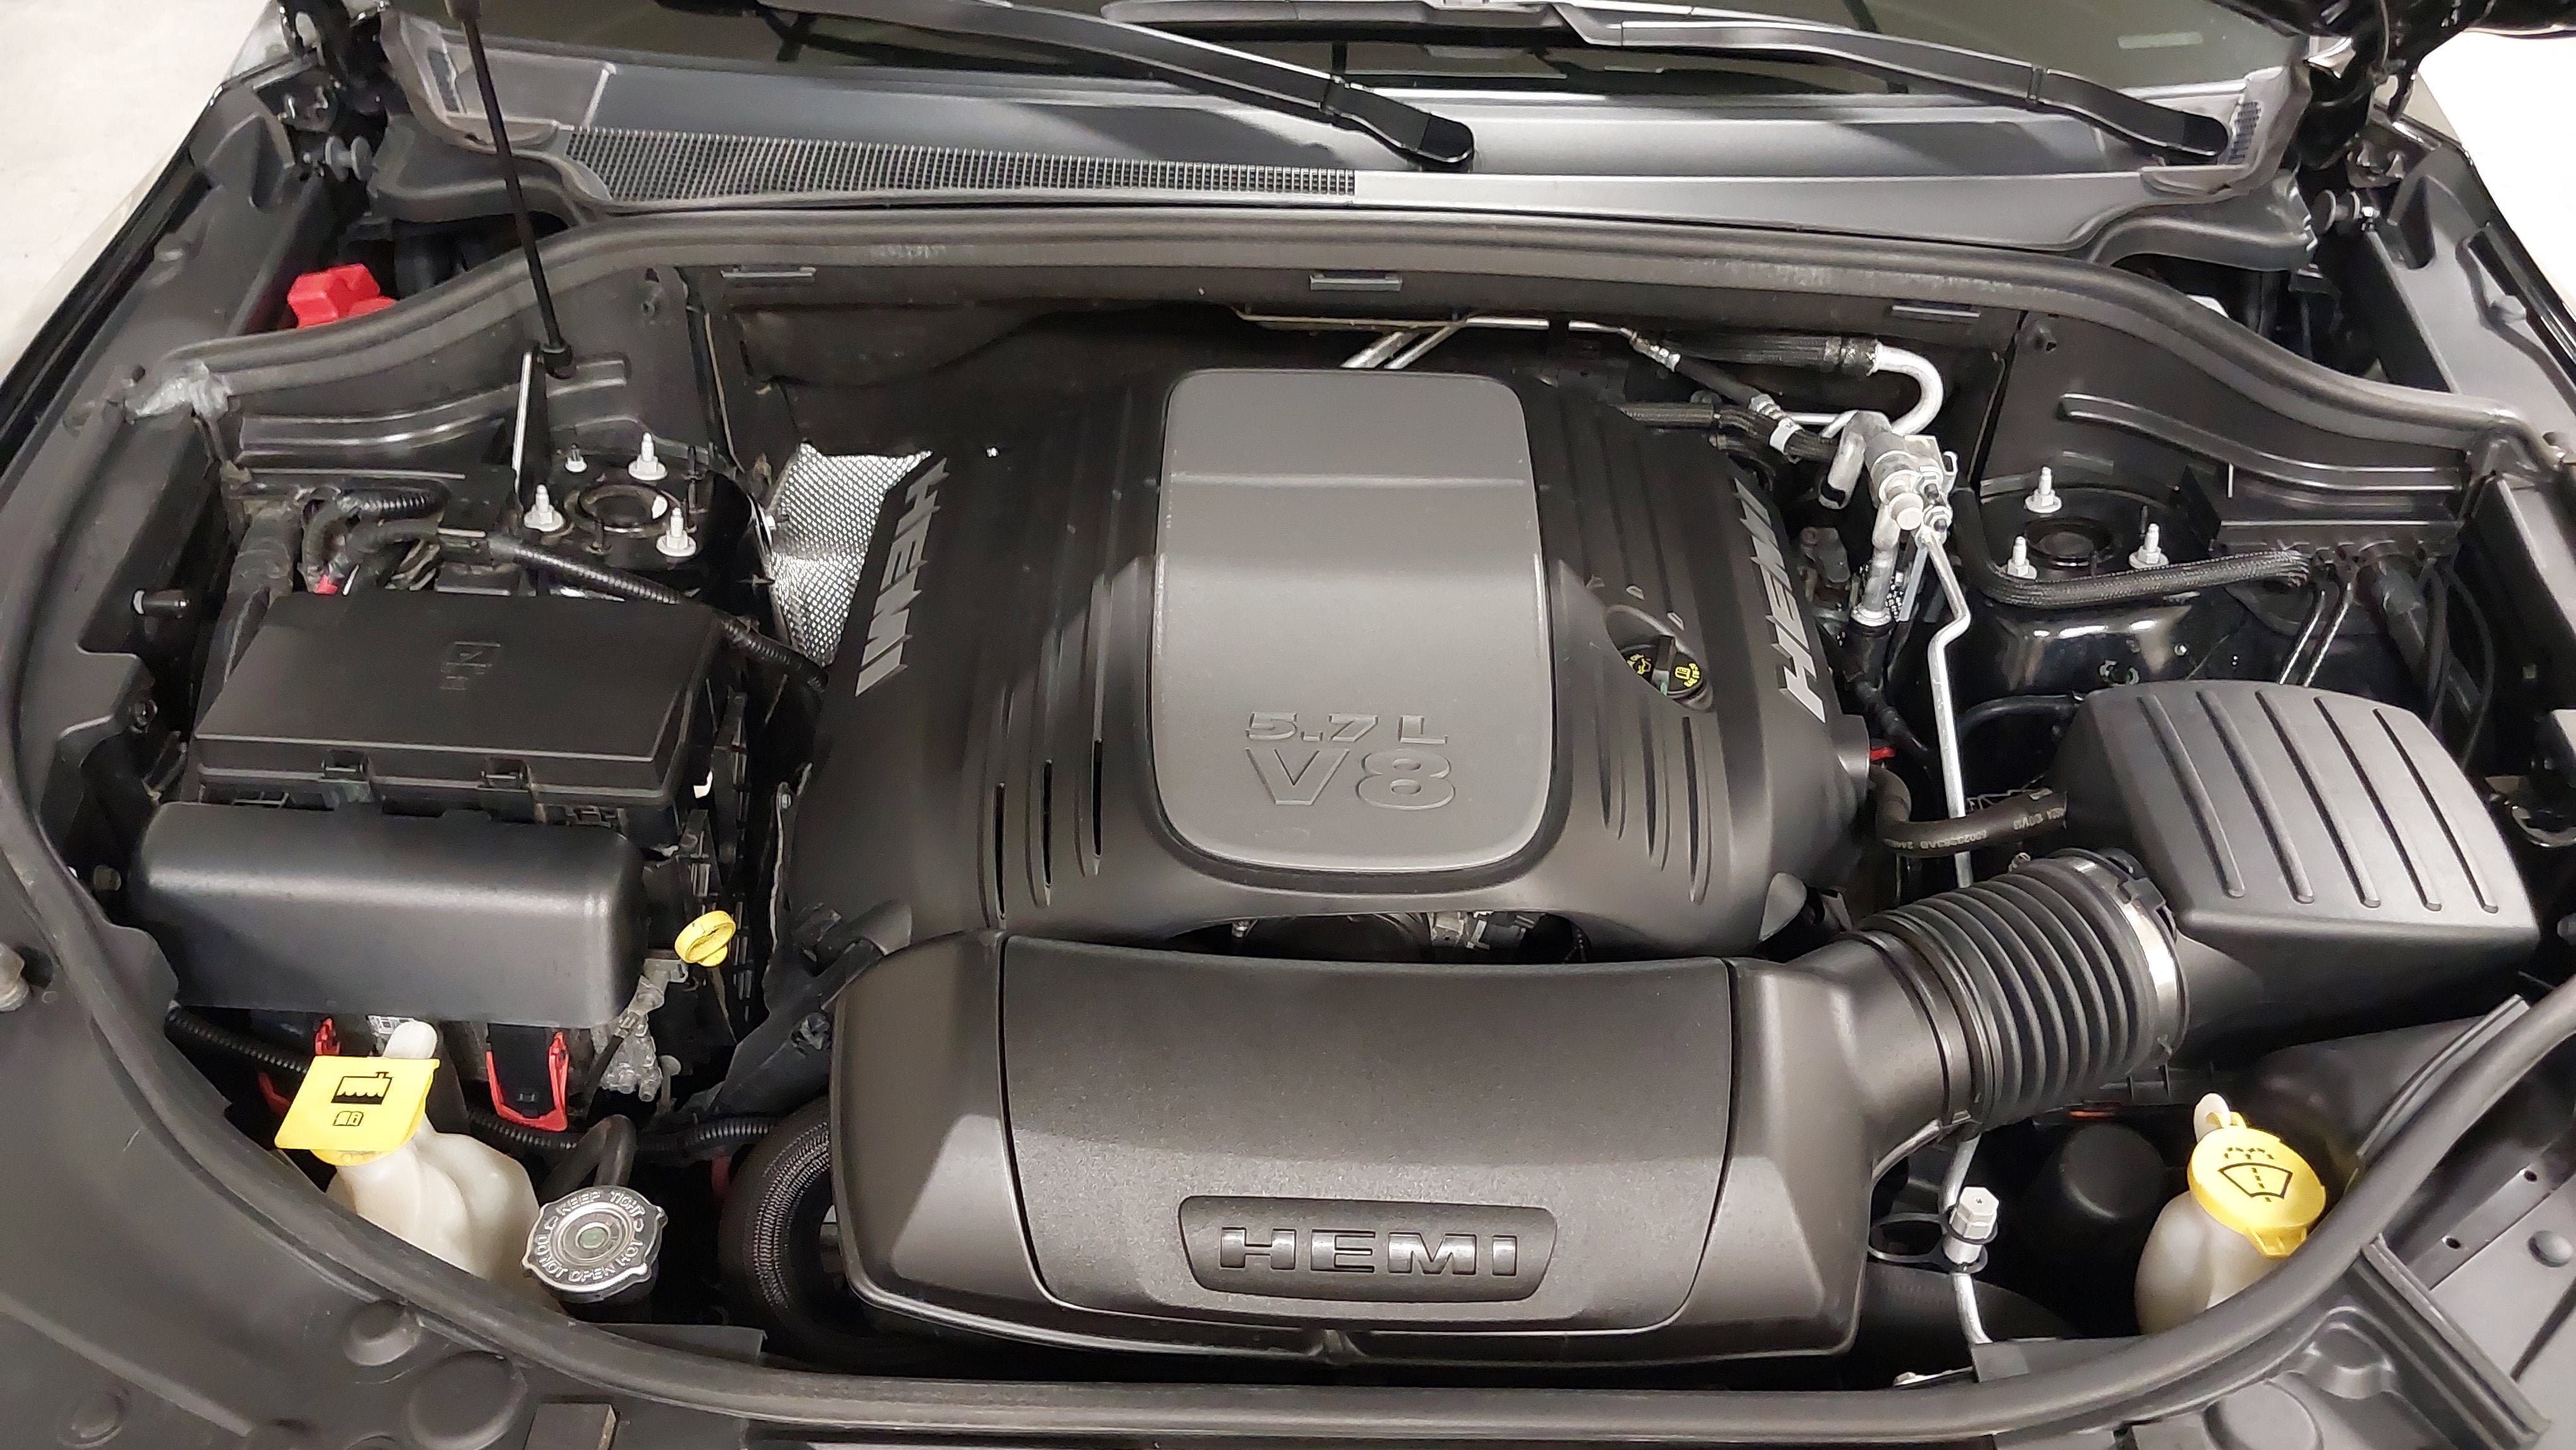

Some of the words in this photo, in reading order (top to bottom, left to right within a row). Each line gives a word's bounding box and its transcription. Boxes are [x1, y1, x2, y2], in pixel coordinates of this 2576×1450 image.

[855, 457, 950, 697] HEMI
[1734, 477, 1826, 724] HEMI
[1245, 746, 1456, 810] V8
[556, 1191, 601, 1216] KEEP
[609, 1190, 646, 1218] TIGHT
[568, 1267, 616, 1283] OPEN
[615, 1240, 644, 1268] HOT
[1220, 1226, 1518, 1276] HEMI
